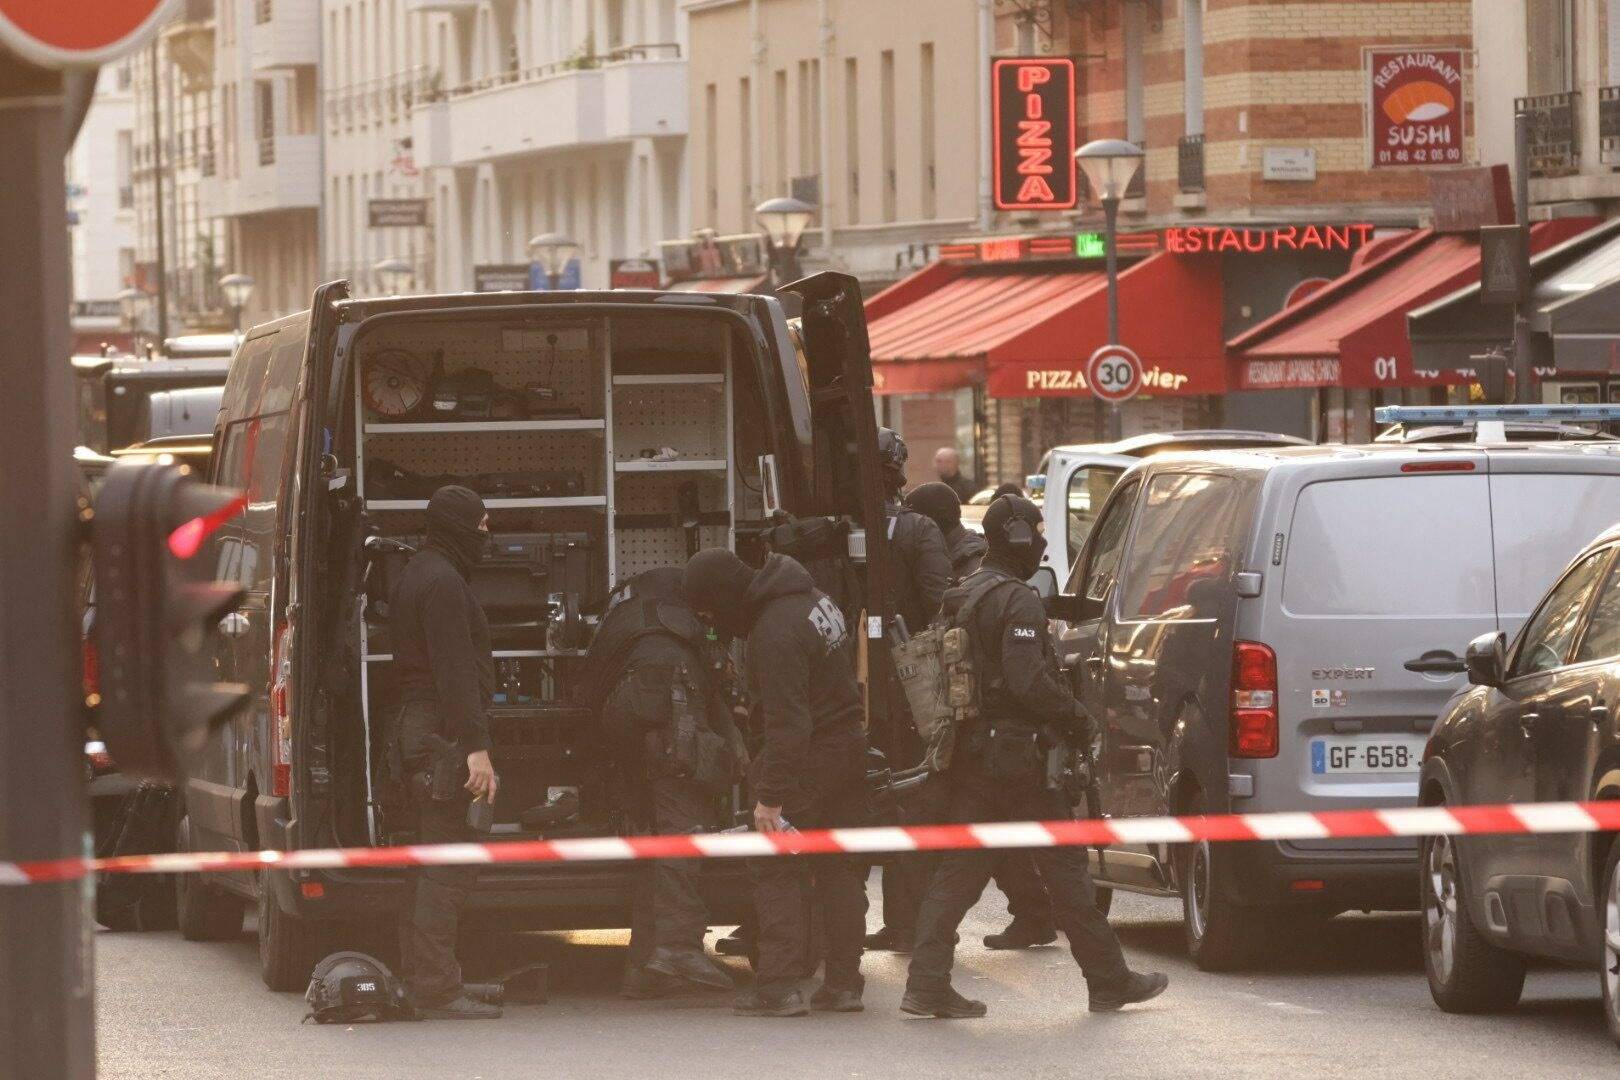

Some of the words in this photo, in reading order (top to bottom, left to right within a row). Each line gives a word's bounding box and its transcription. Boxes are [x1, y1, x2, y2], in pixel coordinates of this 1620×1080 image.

[1375, 54, 1460, 88] RESTAURANT
[1016, 66, 1054, 202] PIZZA
[1387, 125, 1451, 146] SUSHI
[1165, 223, 1375, 253] RESTAURANT
[1026, 370, 1088, 389] PIZZA
[1100, 363, 1131, 385] 30
[1374, 356, 1398, 380] 01
[1311, 666, 1376, 681] EXPERT
